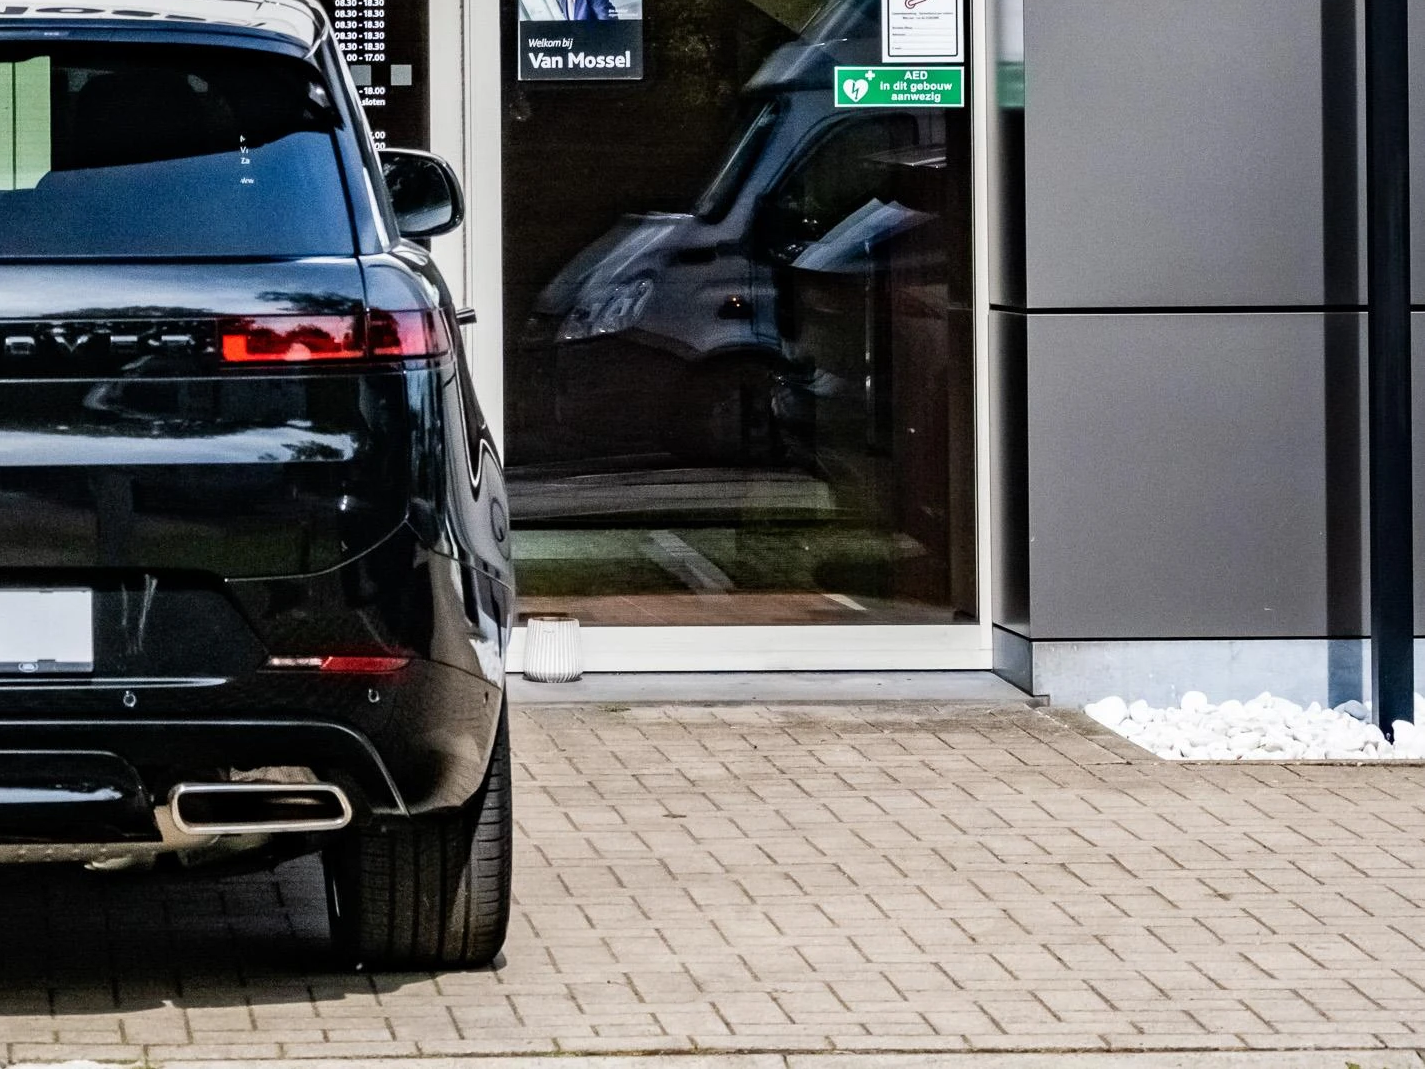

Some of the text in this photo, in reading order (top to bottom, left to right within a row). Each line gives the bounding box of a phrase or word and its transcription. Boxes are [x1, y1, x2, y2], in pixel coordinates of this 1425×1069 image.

[335, 0, 357, 7] 08.30
[364, 0, 385, 7] 18.30
[335, 10, 357, 18] 08.30
[364, 10, 385, 18] 18.30
[335, 21, 357, 29] 08.30
[364, 21, 385, 29] 18.30
[364, 32, 385, 40] 18.30
[364, 43, 385, 51] 18.30
[528, 38, 573, 50] Welkom bij
[528, 50, 631, 69] Van Mossel
[904, 71, 928, 80] AED
[893, 81, 907, 91] dit
[910, 81, 953, 92] gebouw
[361, 97, 386, 106] sloten
[891, 92, 941, 102] aanwezig
